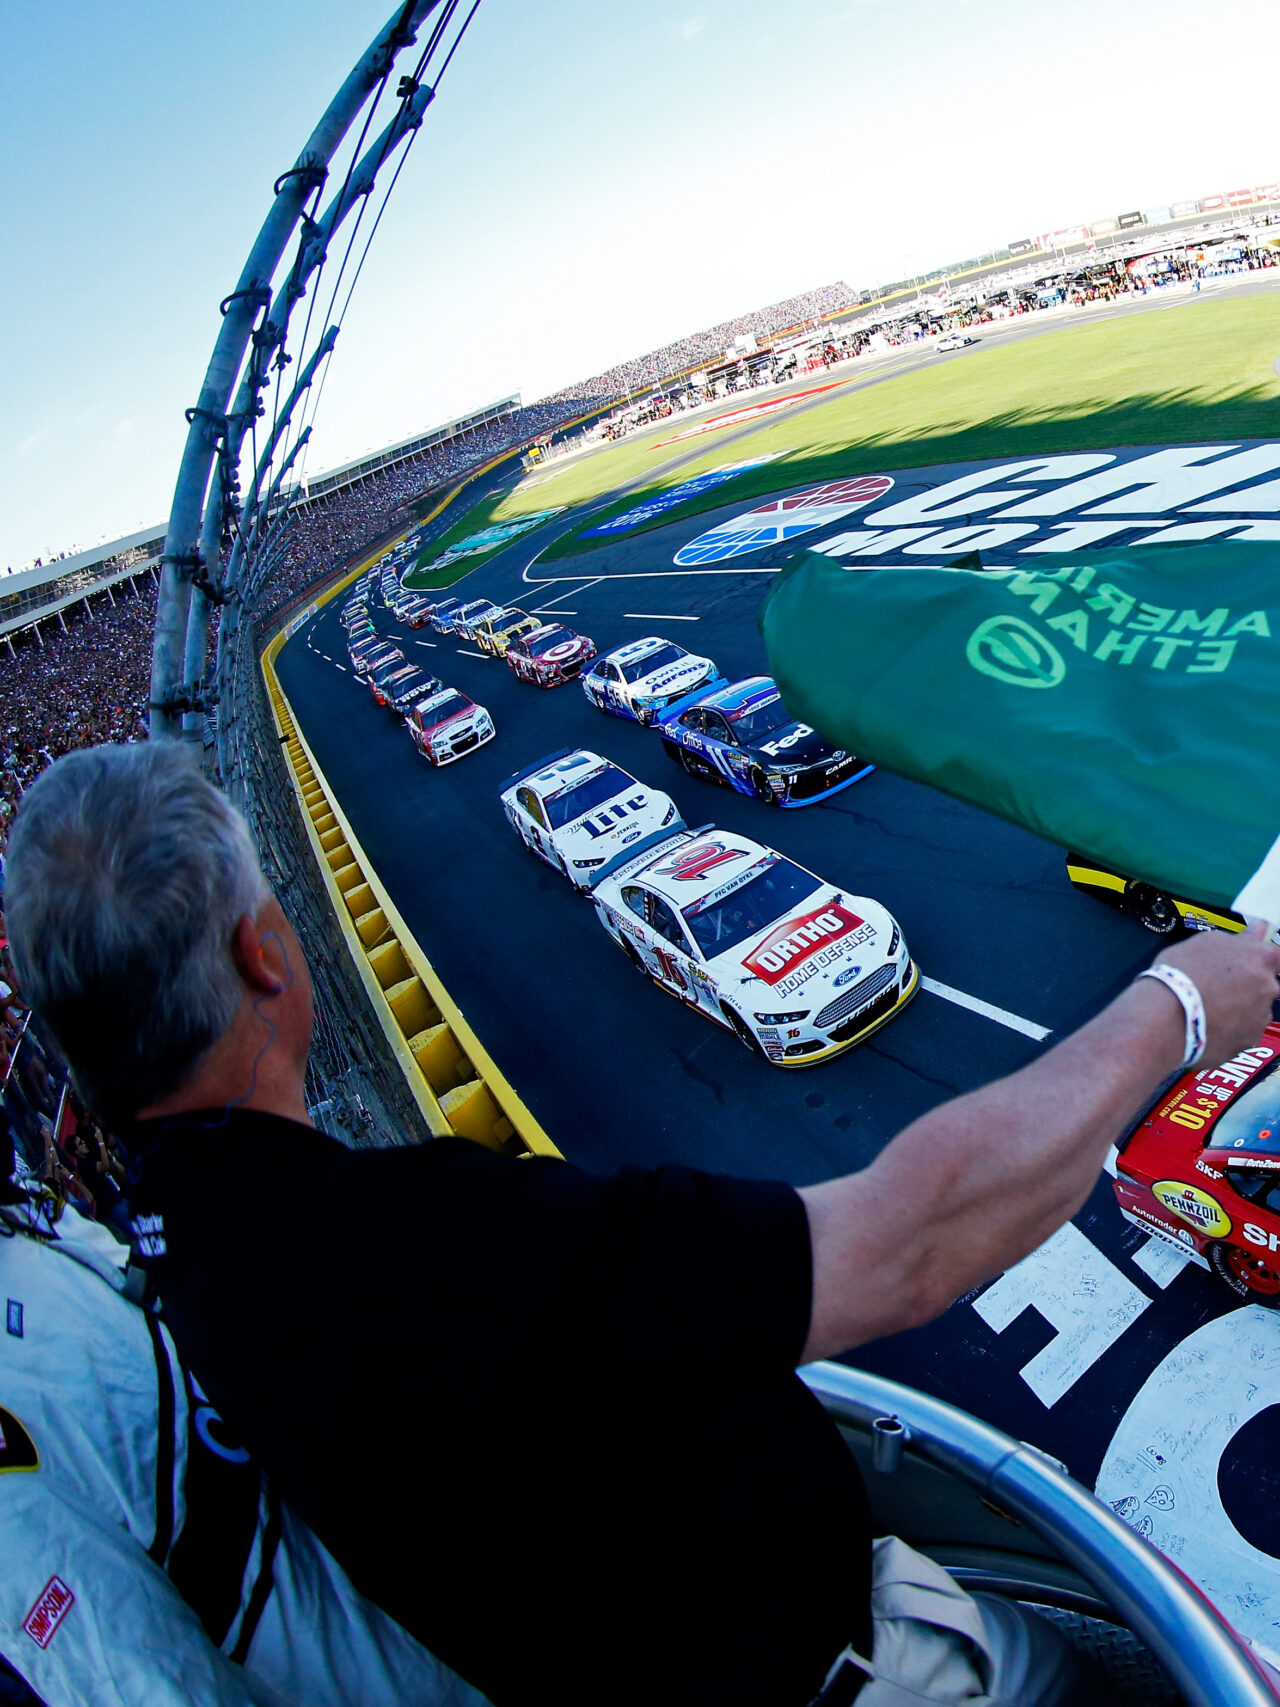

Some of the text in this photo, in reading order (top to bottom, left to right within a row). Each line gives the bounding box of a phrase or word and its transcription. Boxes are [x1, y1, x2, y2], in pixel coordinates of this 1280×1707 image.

[651, 662, 707, 694] Aaron's
[705, 745, 737, 778] 11
[825, 756, 856, 776] CAMR
[581, 794, 649, 840] Lite
[727, 881, 738, 891] VAN
[755, 912, 845, 973] ORTHO
[774, 923, 878, 999] HOME DEFENSE
[836, 968, 859, 985] Ford
[1208, 1046, 1275, 1088] SAVE
[1158, 1089, 1189, 1118] PENNZOIL.COM
[1196, 1082, 1218, 1096] TO
[1215, 1087, 1234, 1102] UP
[1169, 1097, 1220, 1130] $10
[1195, 1160, 1224, 1180] SKF
[1132, 1204, 1179, 1234] Autotrader
[1162, 1193, 1221, 1223] PENNZOIL
[26, 1583, 68, 1644] SIMPSON
